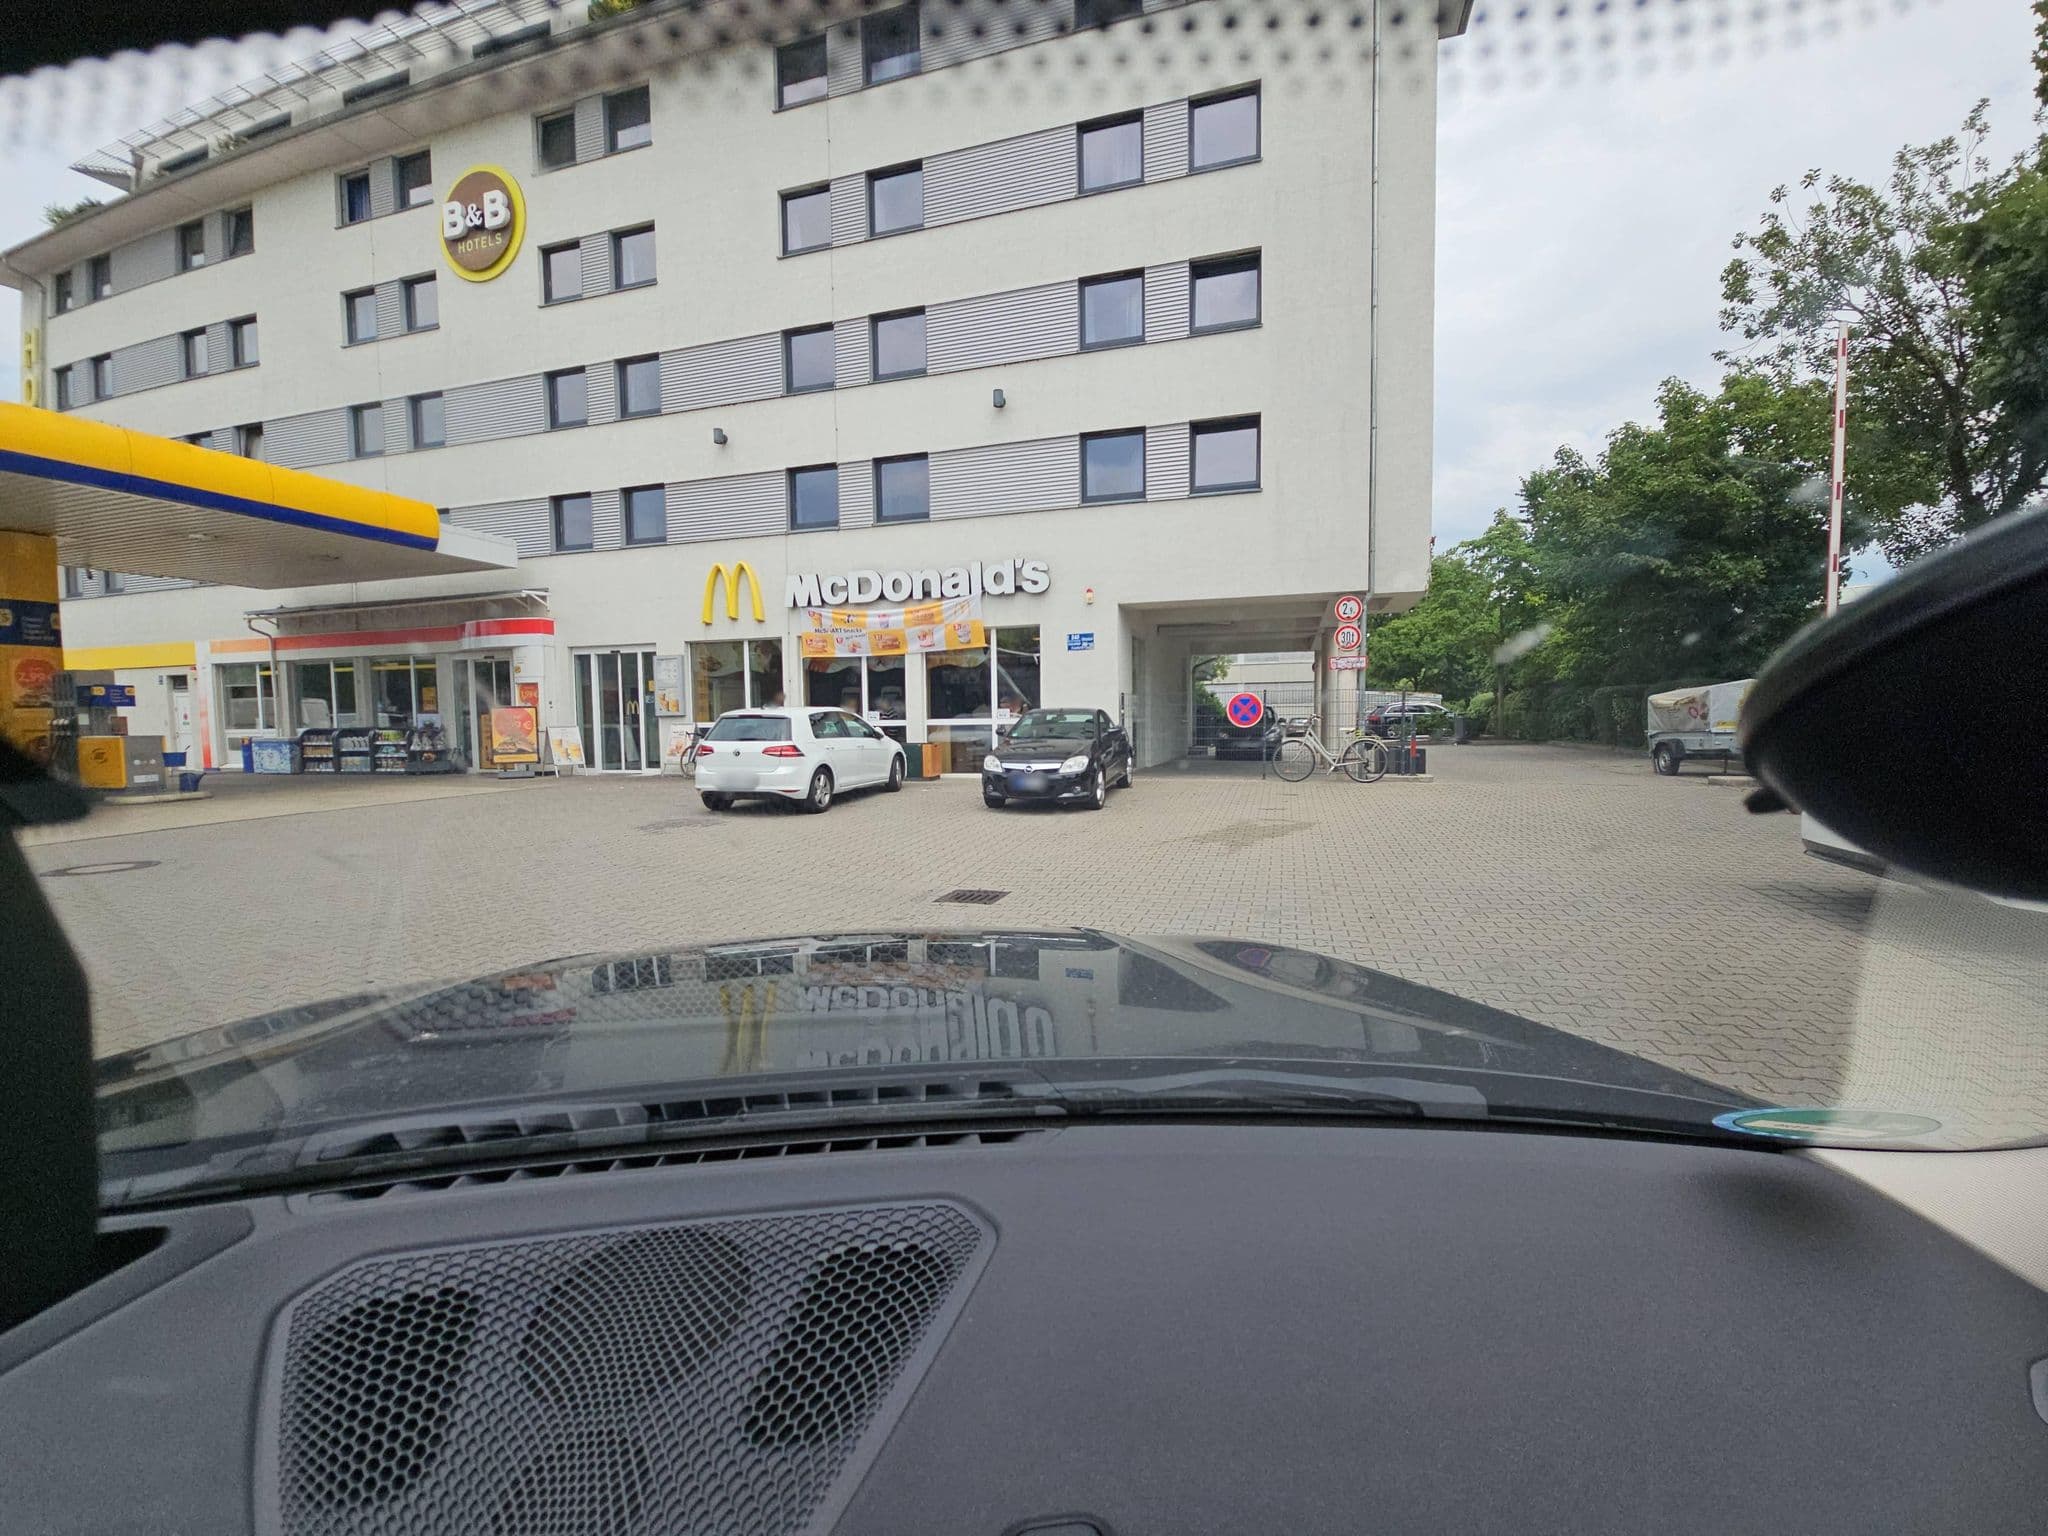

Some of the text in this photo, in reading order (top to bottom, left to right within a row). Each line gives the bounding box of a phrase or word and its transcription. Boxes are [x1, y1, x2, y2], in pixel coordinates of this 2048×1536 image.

[442, 189, 511, 240] B&B
[458, 232, 502, 254] HOTELS
[785, 558, 1051, 608] McDonald's
